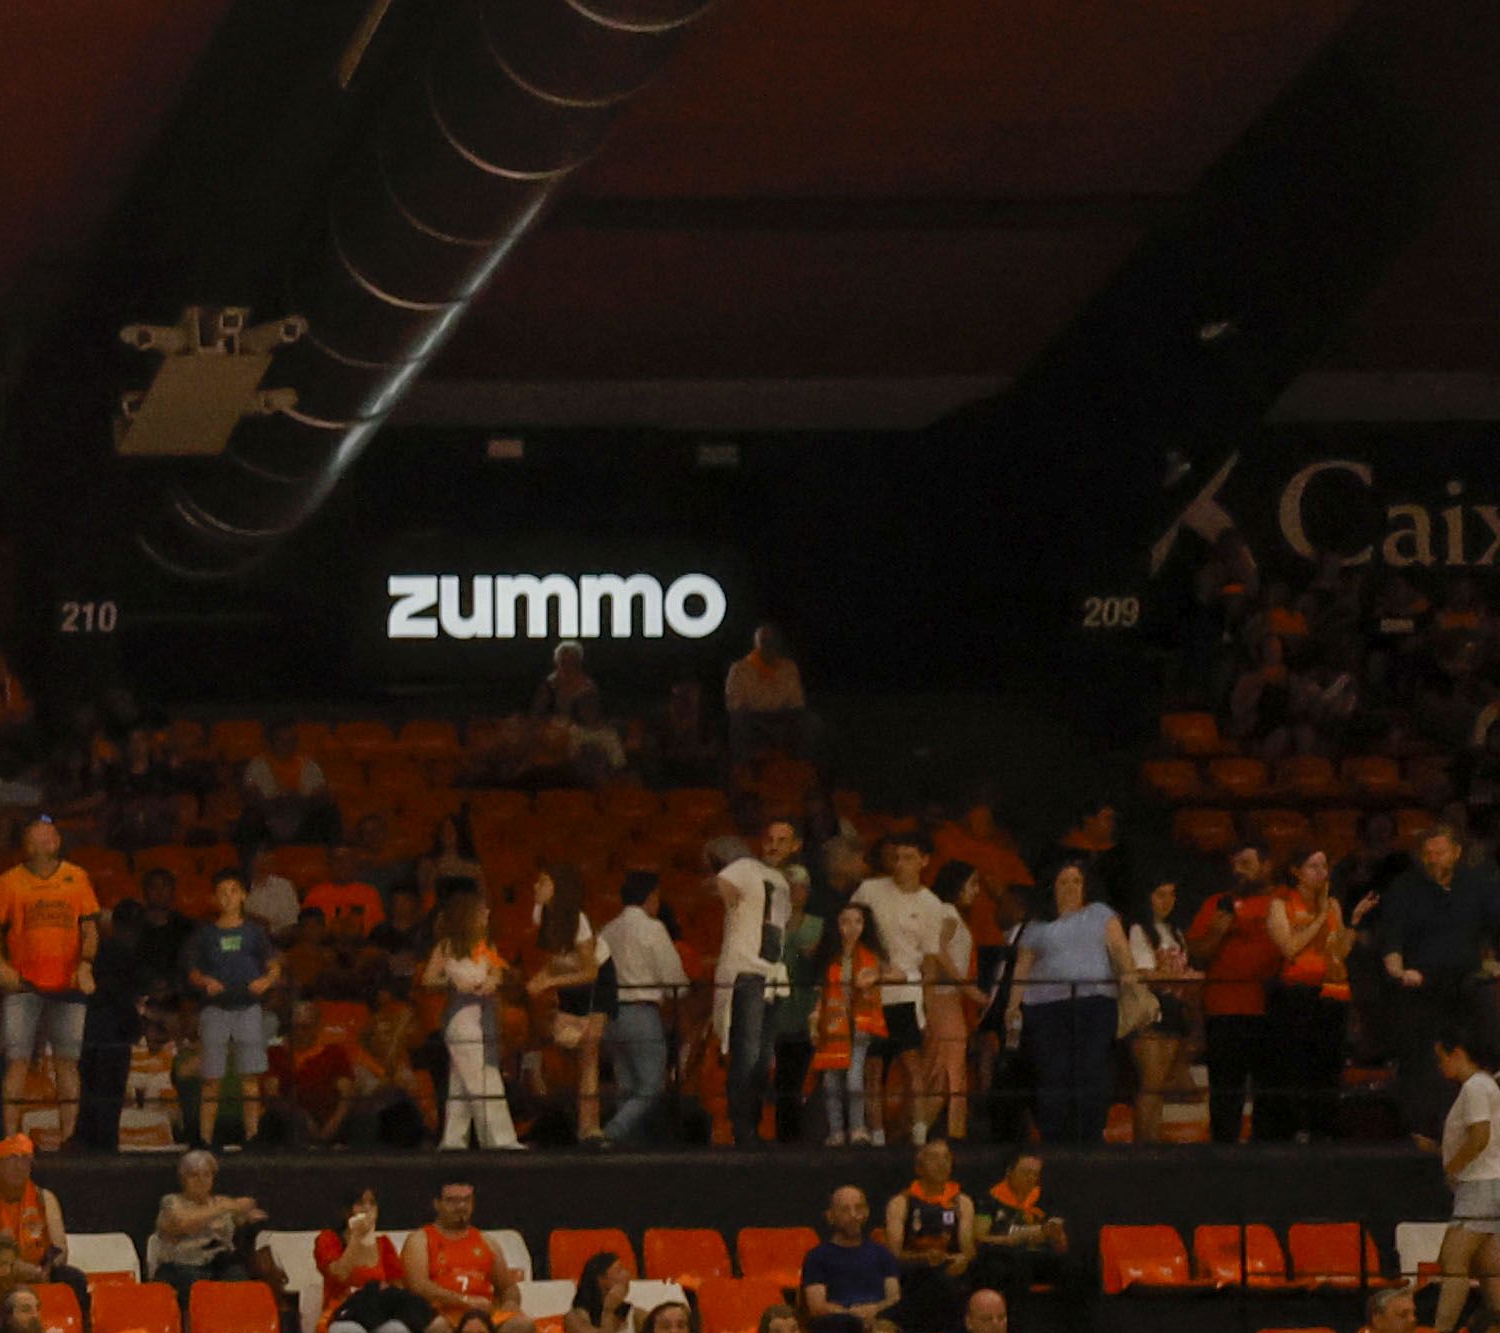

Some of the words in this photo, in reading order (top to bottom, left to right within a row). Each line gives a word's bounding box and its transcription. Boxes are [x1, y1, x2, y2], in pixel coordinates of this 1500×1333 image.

[1277, 460, 1500, 566] Caix
[62, 602, 117, 632] 210
[387, 573, 726, 639] zummo
[1082, 596, 1139, 627] 209
